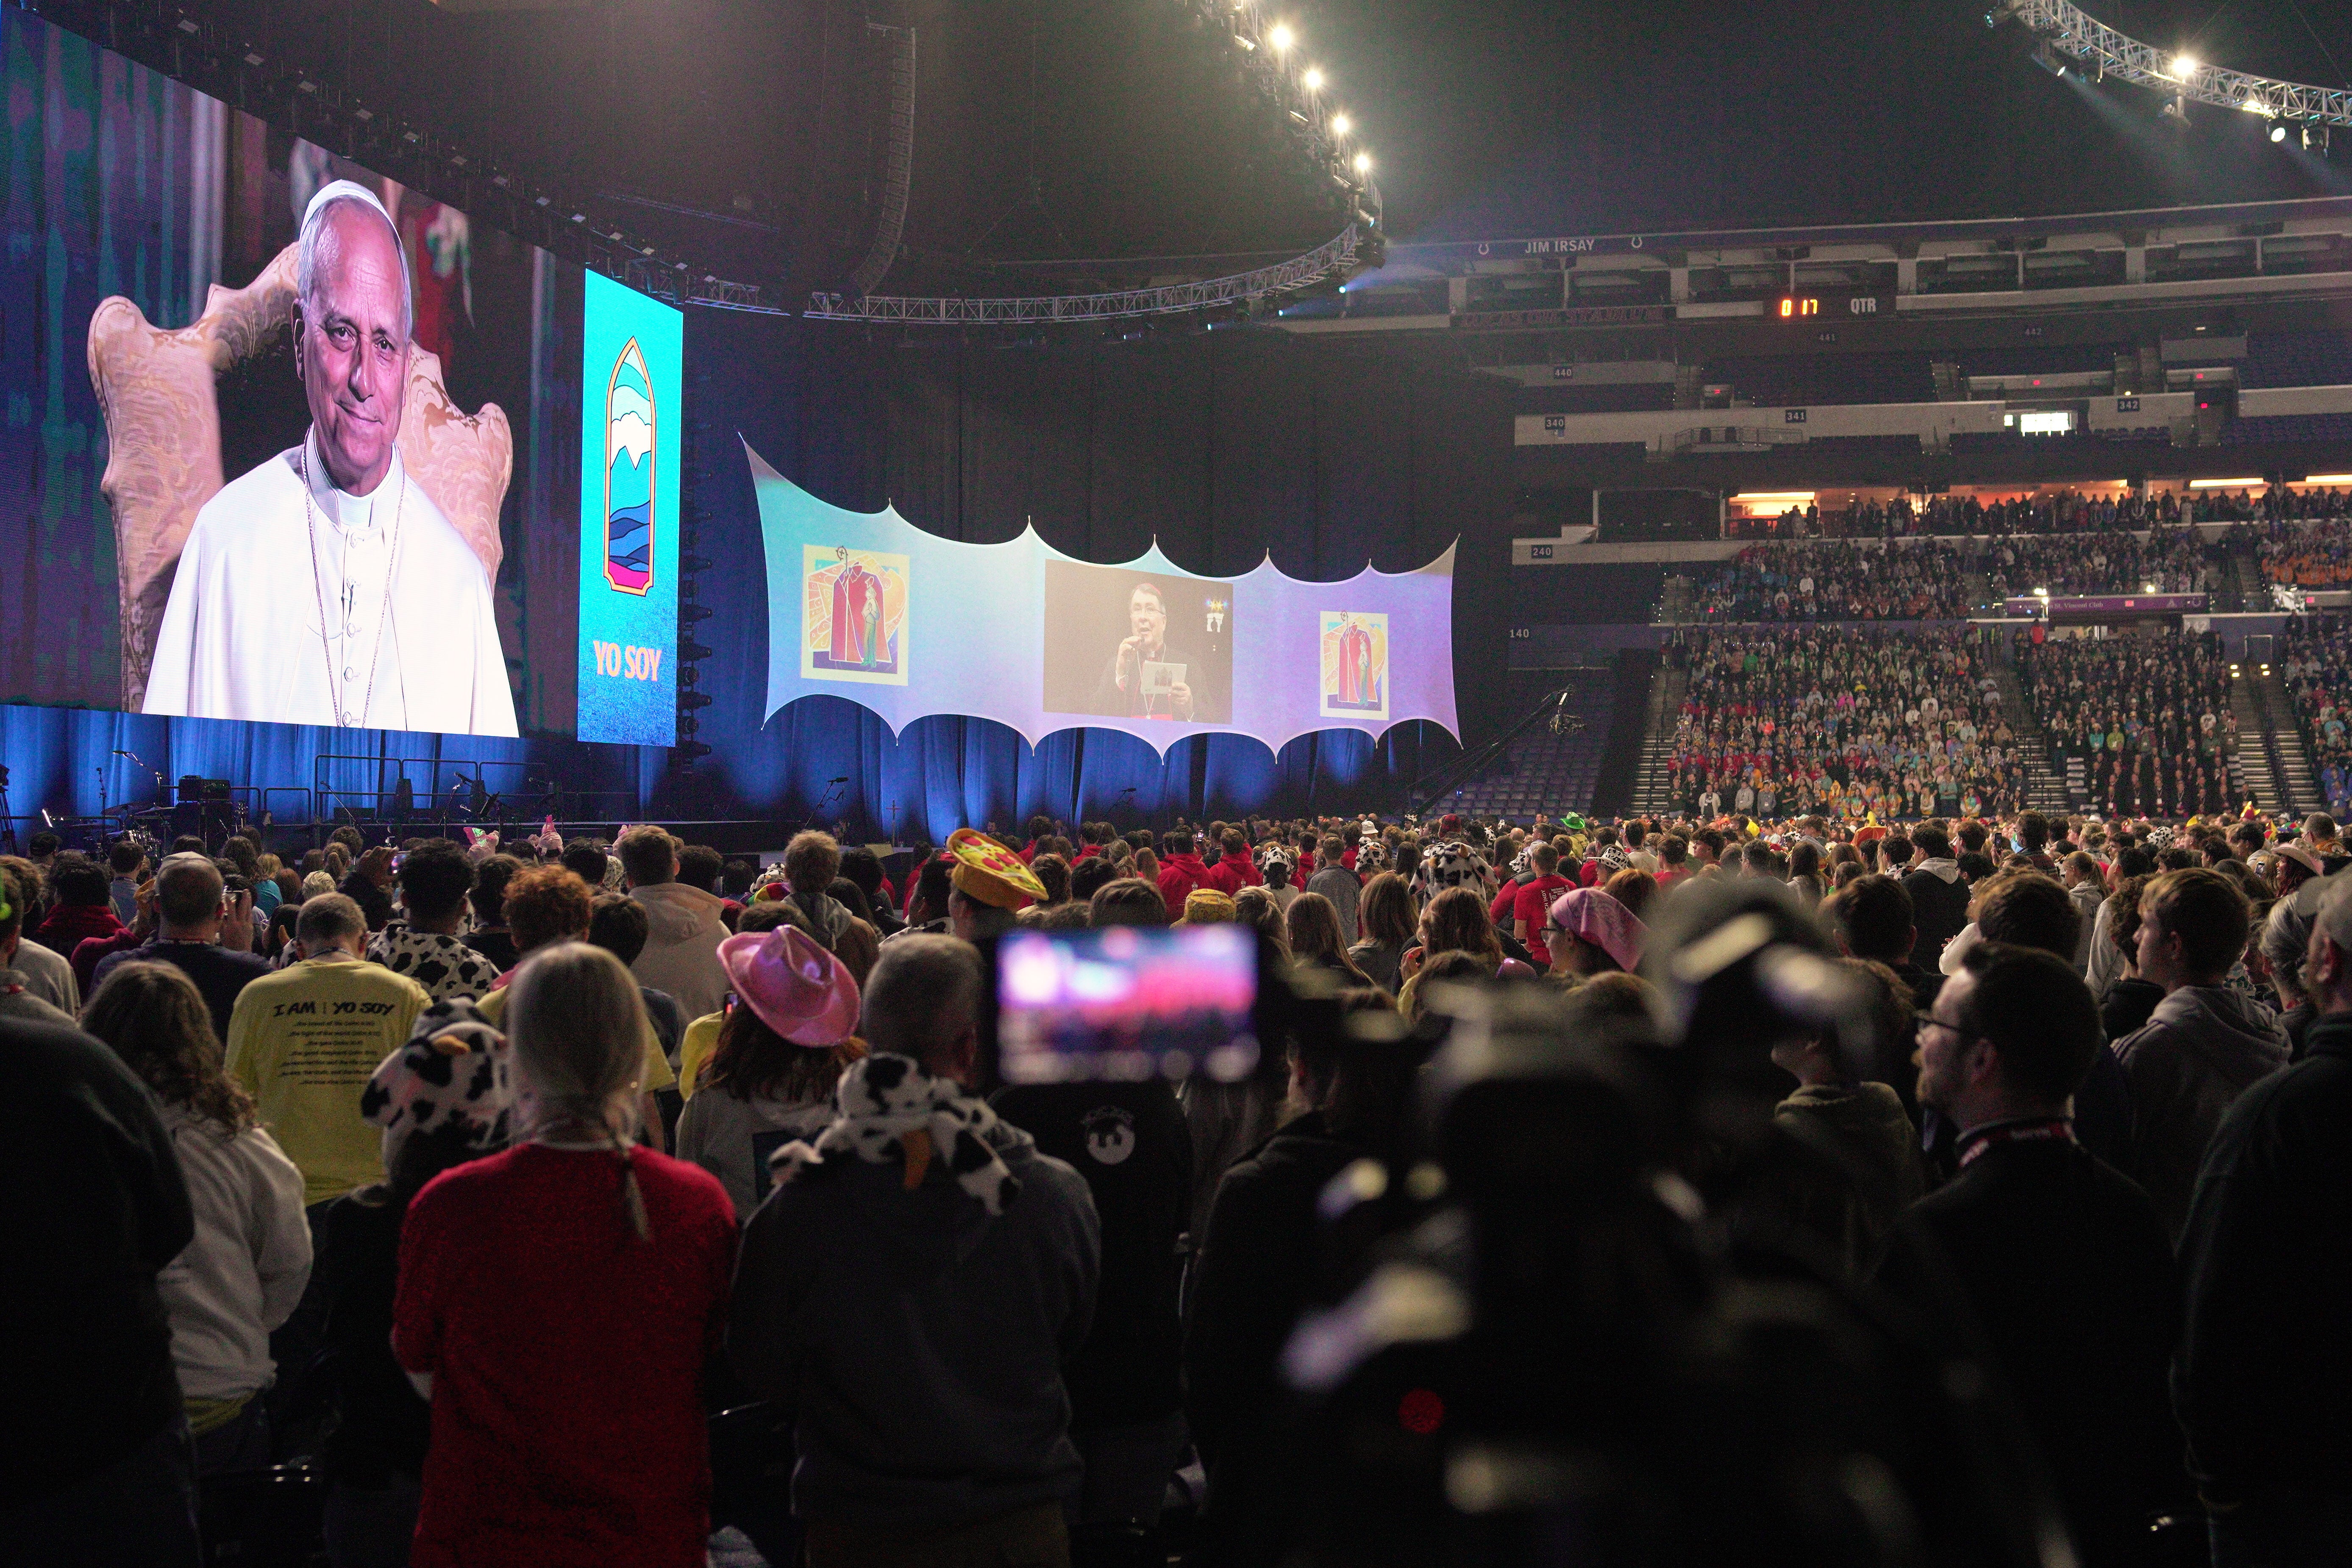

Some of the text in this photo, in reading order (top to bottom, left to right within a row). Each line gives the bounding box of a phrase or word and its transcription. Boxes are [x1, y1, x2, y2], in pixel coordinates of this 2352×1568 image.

[1525, 239, 1595, 253] JIM IRSAY
[1850, 297, 1877, 314] QTR
[1554, 368, 1572, 377] 440
[2120, 400, 2138, 410] 342
[1787, 412, 1804, 420] 341
[1546, 419, 1564, 427] 340
[1533, 547, 1551, 556] 240
[1510, 629, 1529, 638] 140
[593, 640, 662, 681] YO SOY
[1540, 890, 1549, 902] INDY
[273, 1001, 395, 1018] I AM YO SOY
